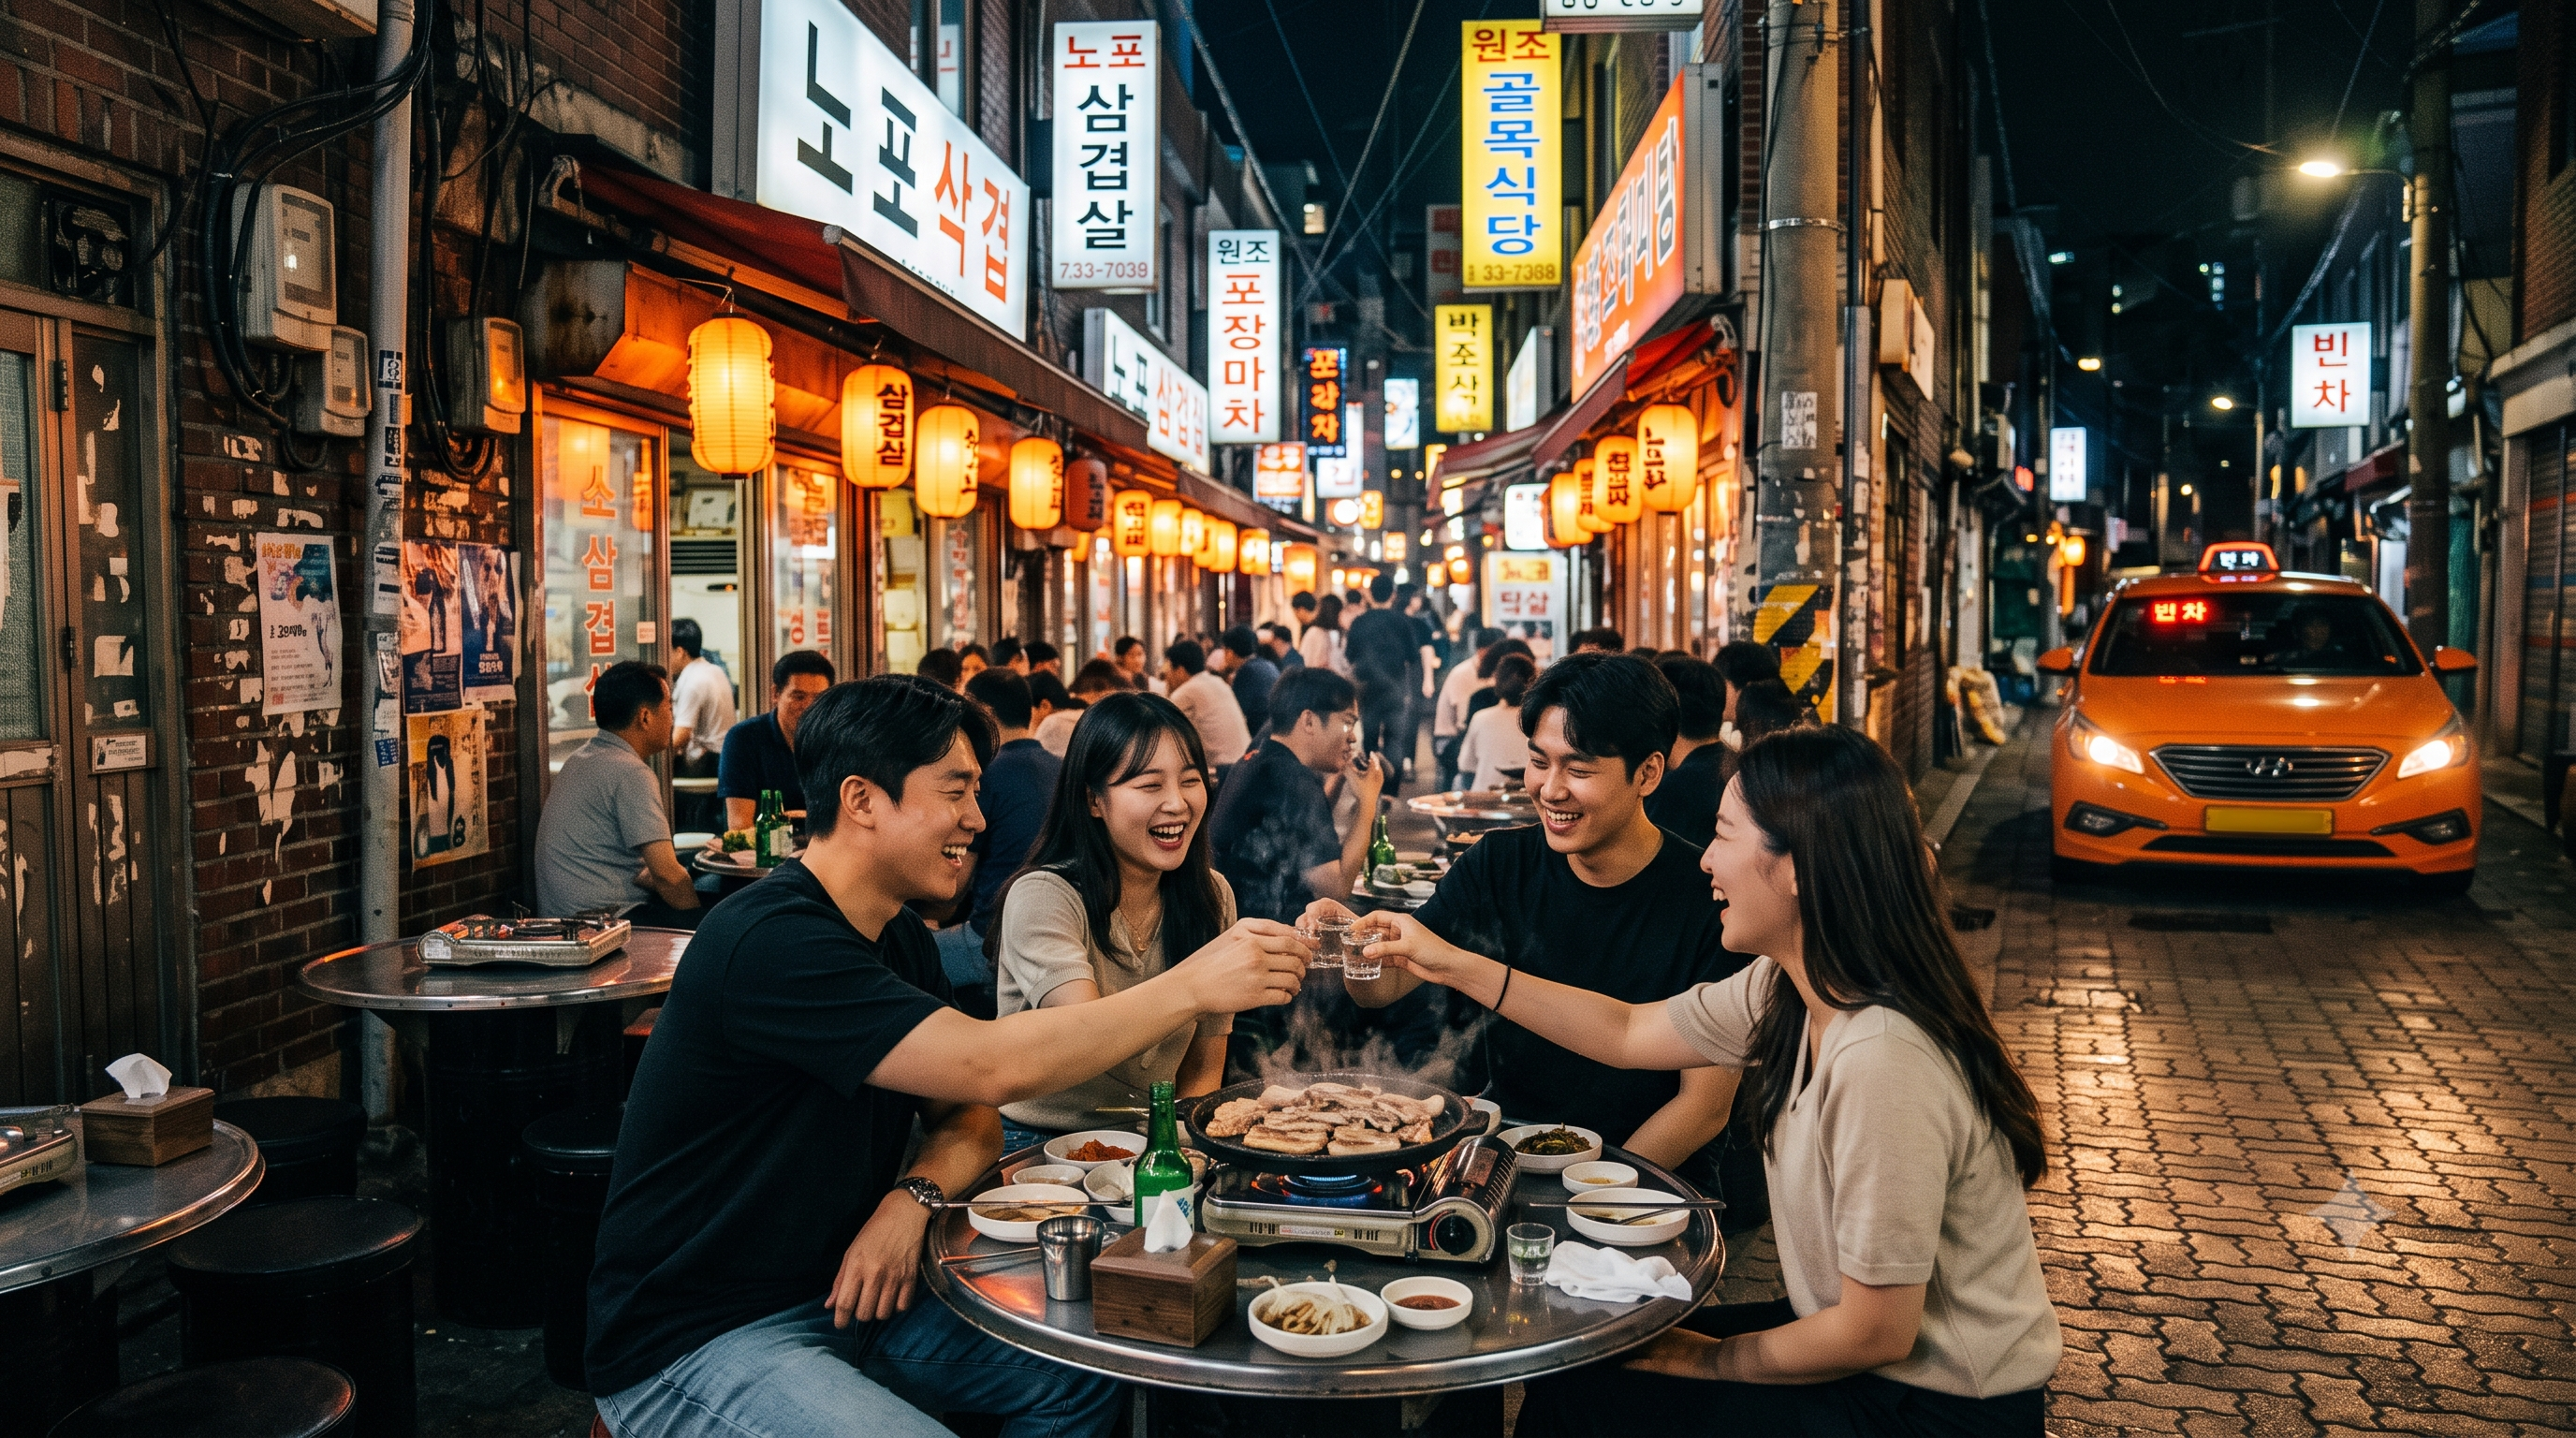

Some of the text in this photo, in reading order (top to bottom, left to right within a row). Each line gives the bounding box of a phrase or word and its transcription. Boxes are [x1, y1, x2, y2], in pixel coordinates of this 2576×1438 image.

[1064, 35, 1146, 68] 노포
[1472, 29, 1550, 62] 원조
[1076, 83, 1134, 249] 삼겹살
[1483, 73, 1541, 255] 골목식당
[1217, 240, 1270, 264] 원조
[1222, 274, 1266, 433] 포장마차
[2313, 331, 2350, 412] 빈차
[2155, 602, 2207, 622] 빈차
